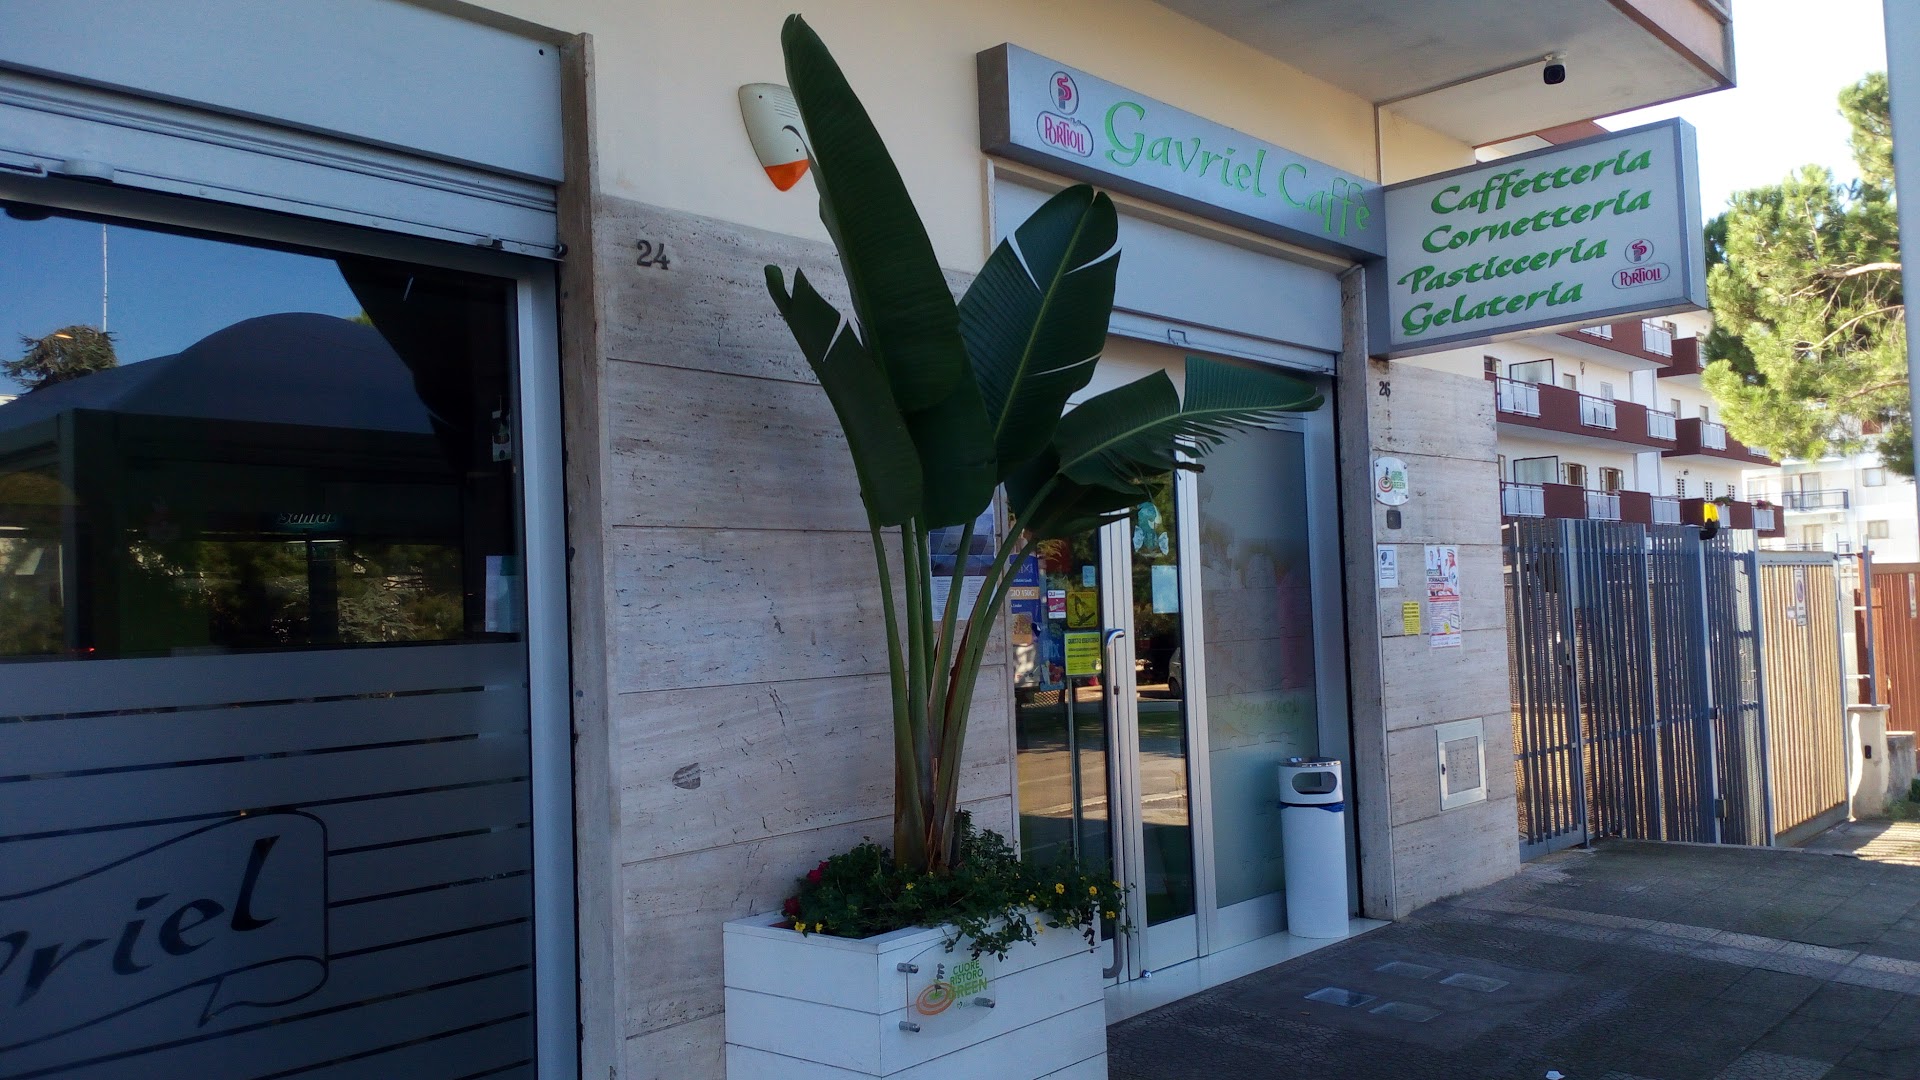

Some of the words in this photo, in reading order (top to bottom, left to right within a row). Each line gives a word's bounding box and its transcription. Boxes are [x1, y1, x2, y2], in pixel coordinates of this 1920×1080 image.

[1044, 115, 1086, 155] PORTIOLI
[1104, 101, 1267, 198] Gavriel
[1430, 149, 1652, 214] Caffetteria
[1421, 188, 1652, 253] Cornetteria
[636, 239, 671, 270] 24
[1396, 237, 1608, 295] Pasticceria
[1620, 267, 1663, 287] PORTIOLI
[1401, 281, 1584, 337] Gelateria
[1379, 380, 1391, 397] 26
[950, 968, 984, 985] RISTORO
[953, 960, 980, 975] CUORE
